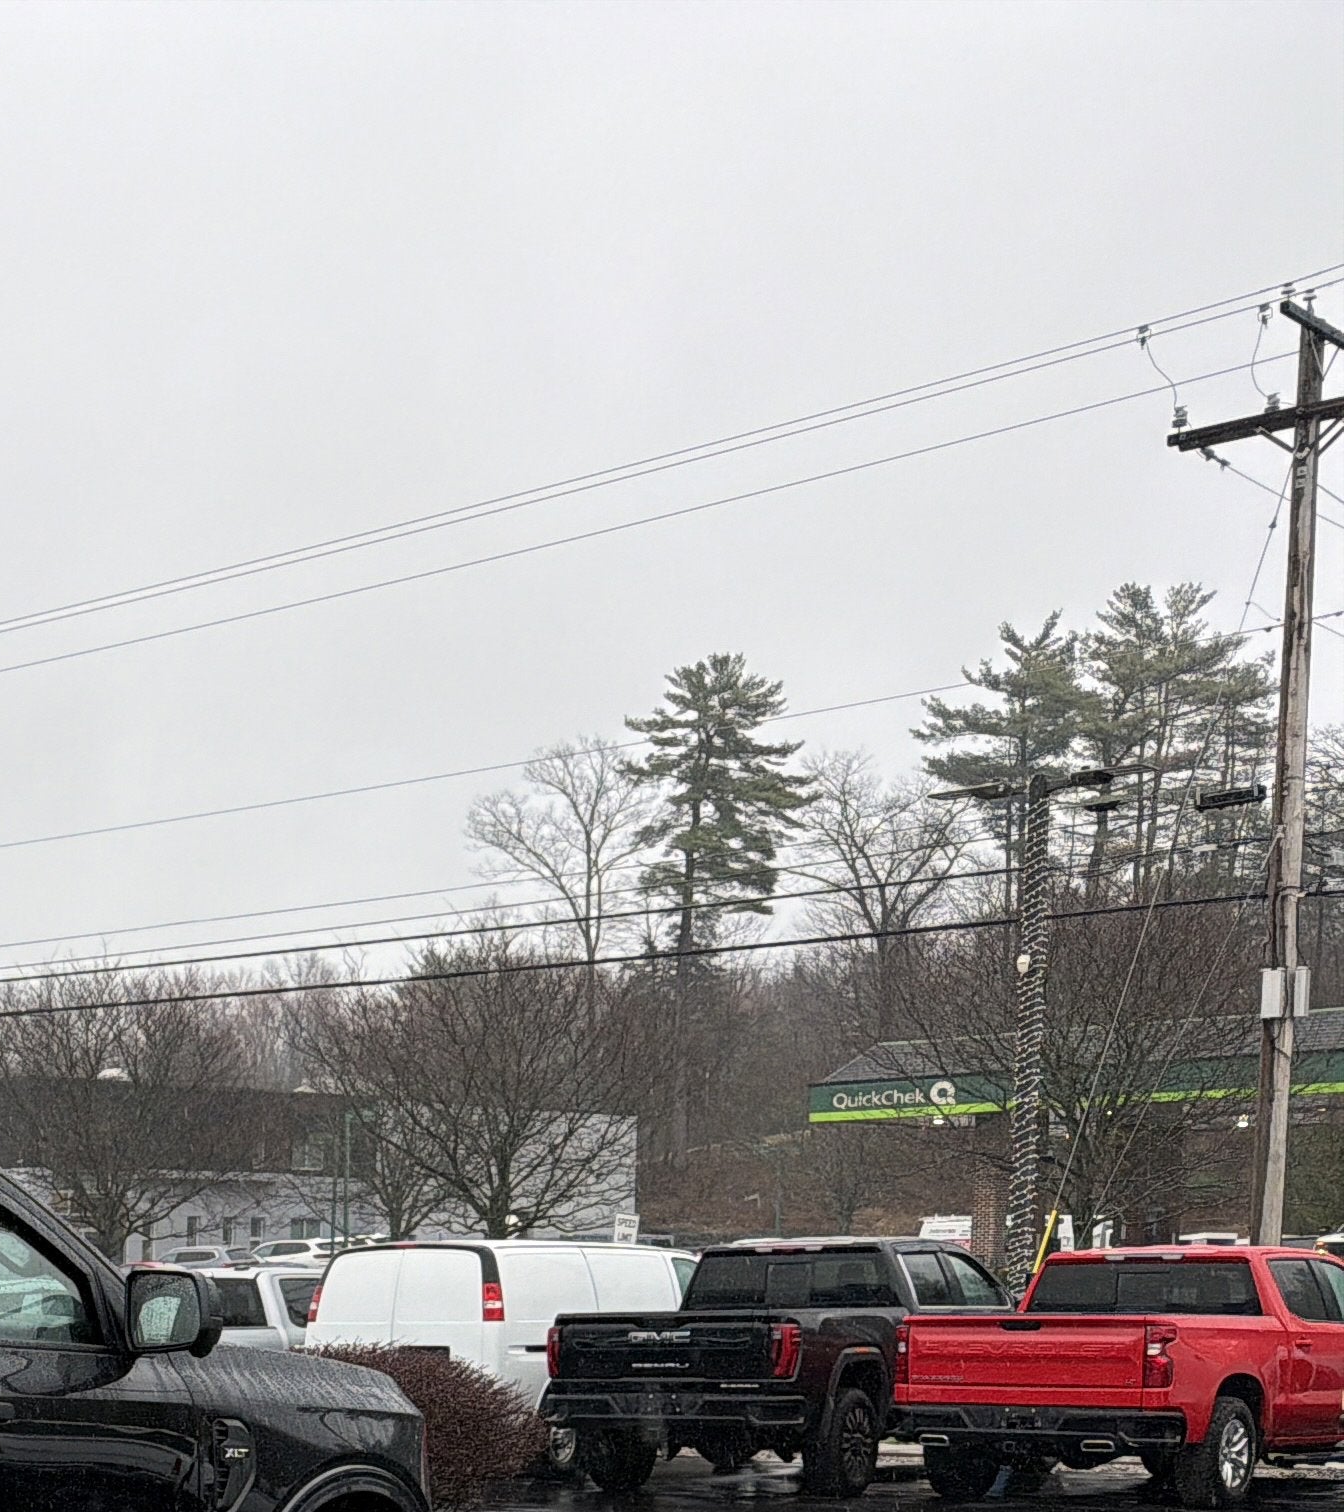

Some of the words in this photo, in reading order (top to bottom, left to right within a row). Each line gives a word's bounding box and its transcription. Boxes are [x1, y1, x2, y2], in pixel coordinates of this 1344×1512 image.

[832, 1088, 926, 1109] QuickChek
[616, 1217, 637, 1229] SPEED
[628, 1331, 691, 1343] GMC
[224, 1447, 249, 1458] XLT
